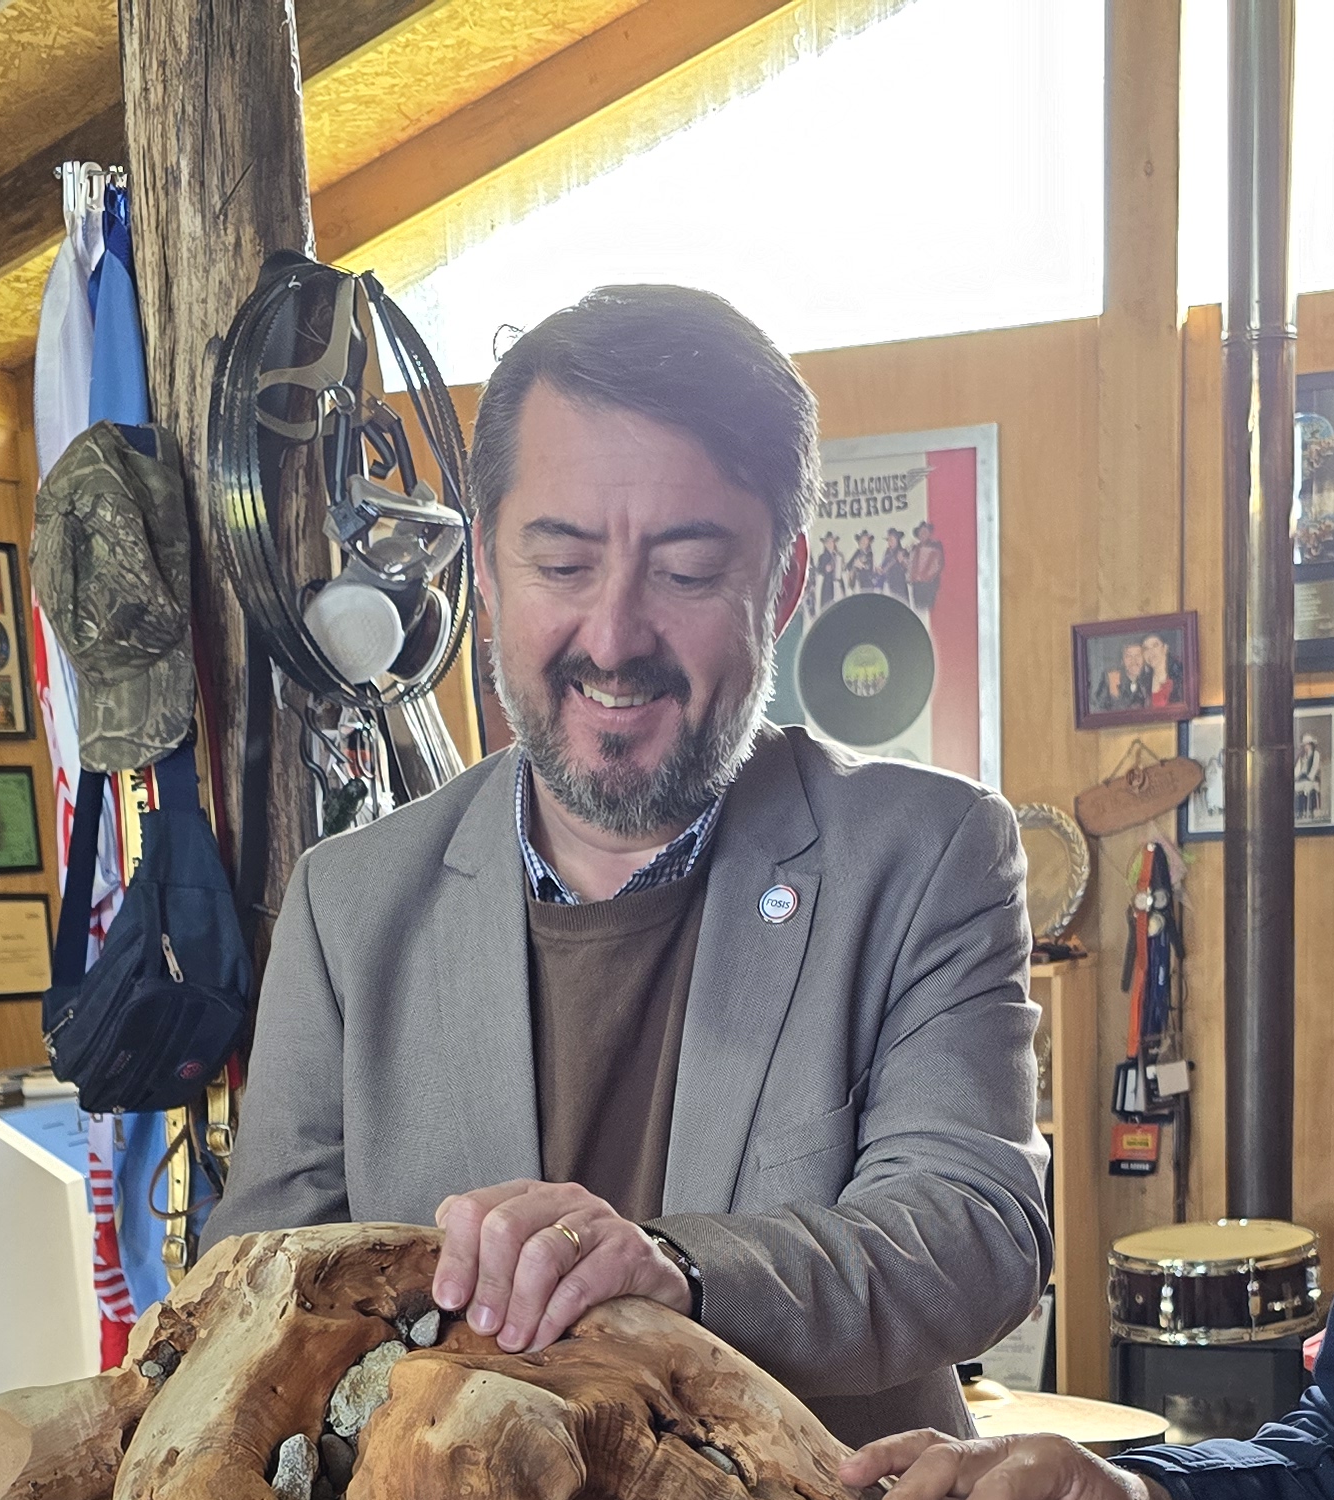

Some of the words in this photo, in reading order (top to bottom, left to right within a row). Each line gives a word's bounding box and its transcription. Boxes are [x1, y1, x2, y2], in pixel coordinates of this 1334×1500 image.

[843, 475, 907, 498] HALCONES
[817, 493, 908, 519] NEGROS
[766, 898, 791, 909] FOSIS
